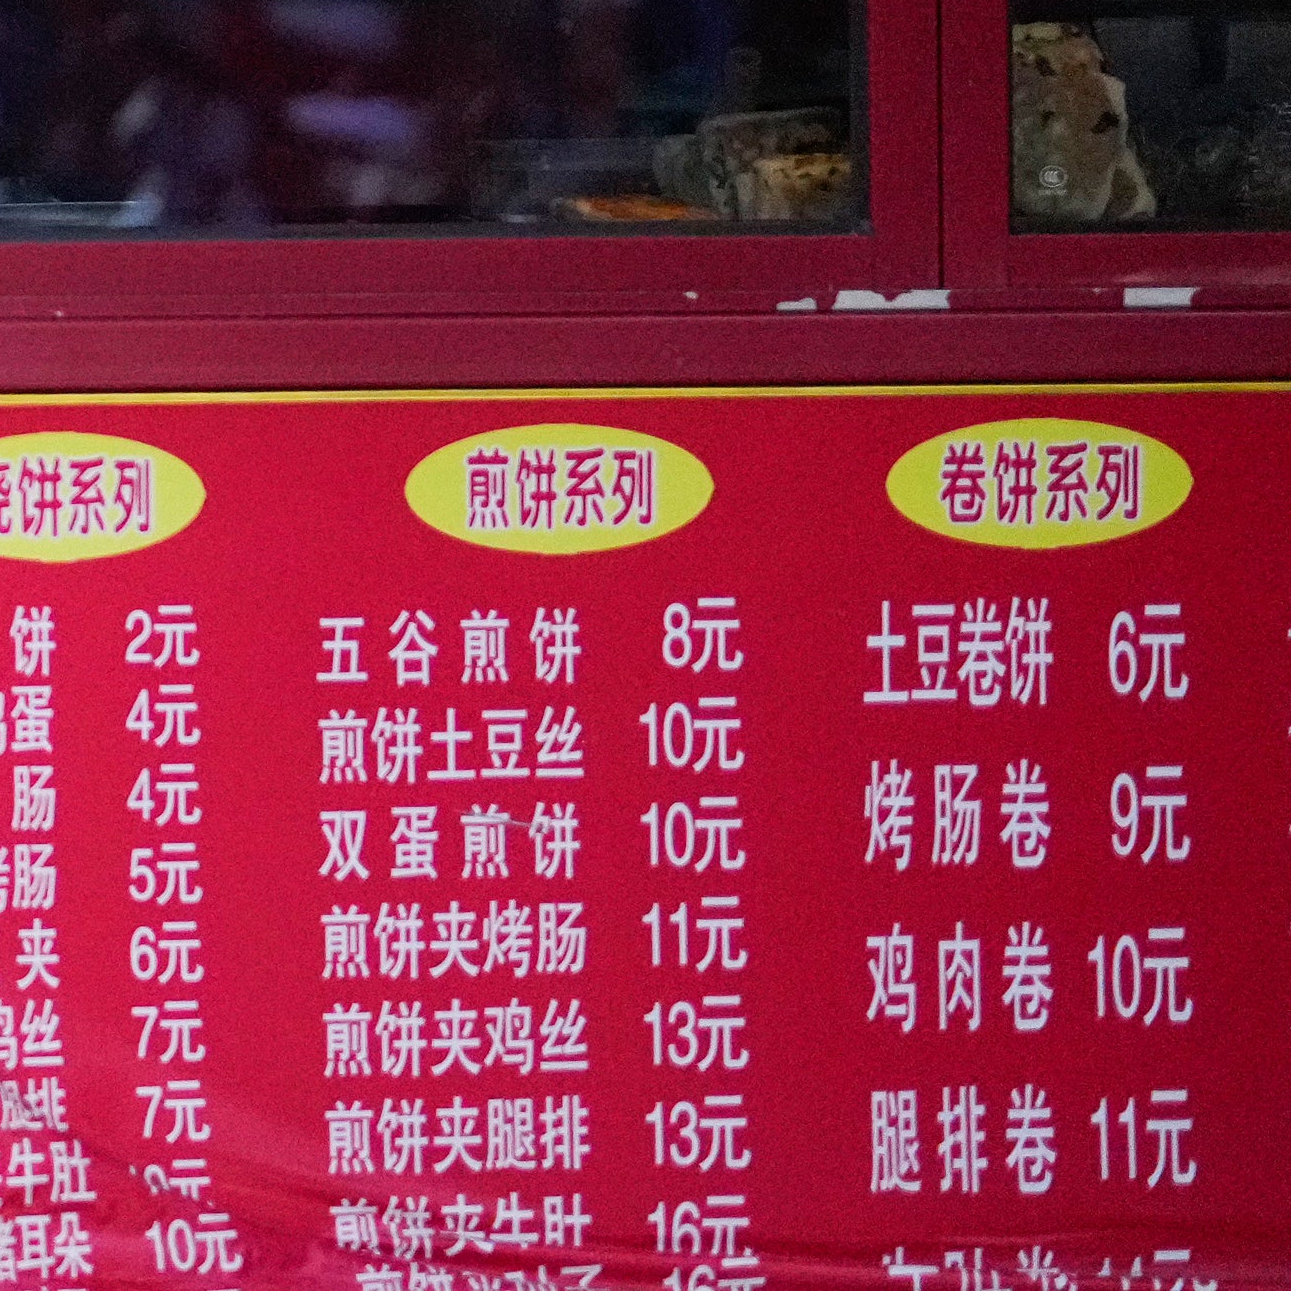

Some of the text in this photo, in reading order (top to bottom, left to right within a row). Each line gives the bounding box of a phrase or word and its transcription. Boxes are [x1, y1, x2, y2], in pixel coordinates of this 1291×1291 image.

[465, 447, 655, 530] 煎饼系列
[940, 441, 1140, 525] 卷饼系列
[125, 605, 200, 668] 2元
[316, 597, 743, 686] 五谷煎饼 8元
[864, 597, 1188, 706] 土豆卷饼 6元
[126, 684, 201, 747] 4元
[318, 697, 744, 783] 煎饼土豆丝 10元
[127, 763, 202, 826] 4元
[864, 759, 1190, 871] 烤肠卷 9元
[129, 843, 203, 905] 5元
[319, 797, 745, 881] 双蛋煎饼 10元
[130, 921, 204, 984] 6元
[321, 896, 747, 979] 煎饼夹烤肠 11元
[867, 922, 1192, 1032] 鸡肉卷 10元
[131, 1000, 205, 1063] 7元
[323, 995, 749, 1077] 煎饼夹鸡丝 13元
[136, 1080, 211, 1143] 7元
[325, 1095, 751, 1174] 煎饼夹腿排 13元
[871, 1084, 1196, 1193] 腿排卷 11元
[145, 1213, 243, 1274] 10元
[648, 1195, 752, 1255] 16元
